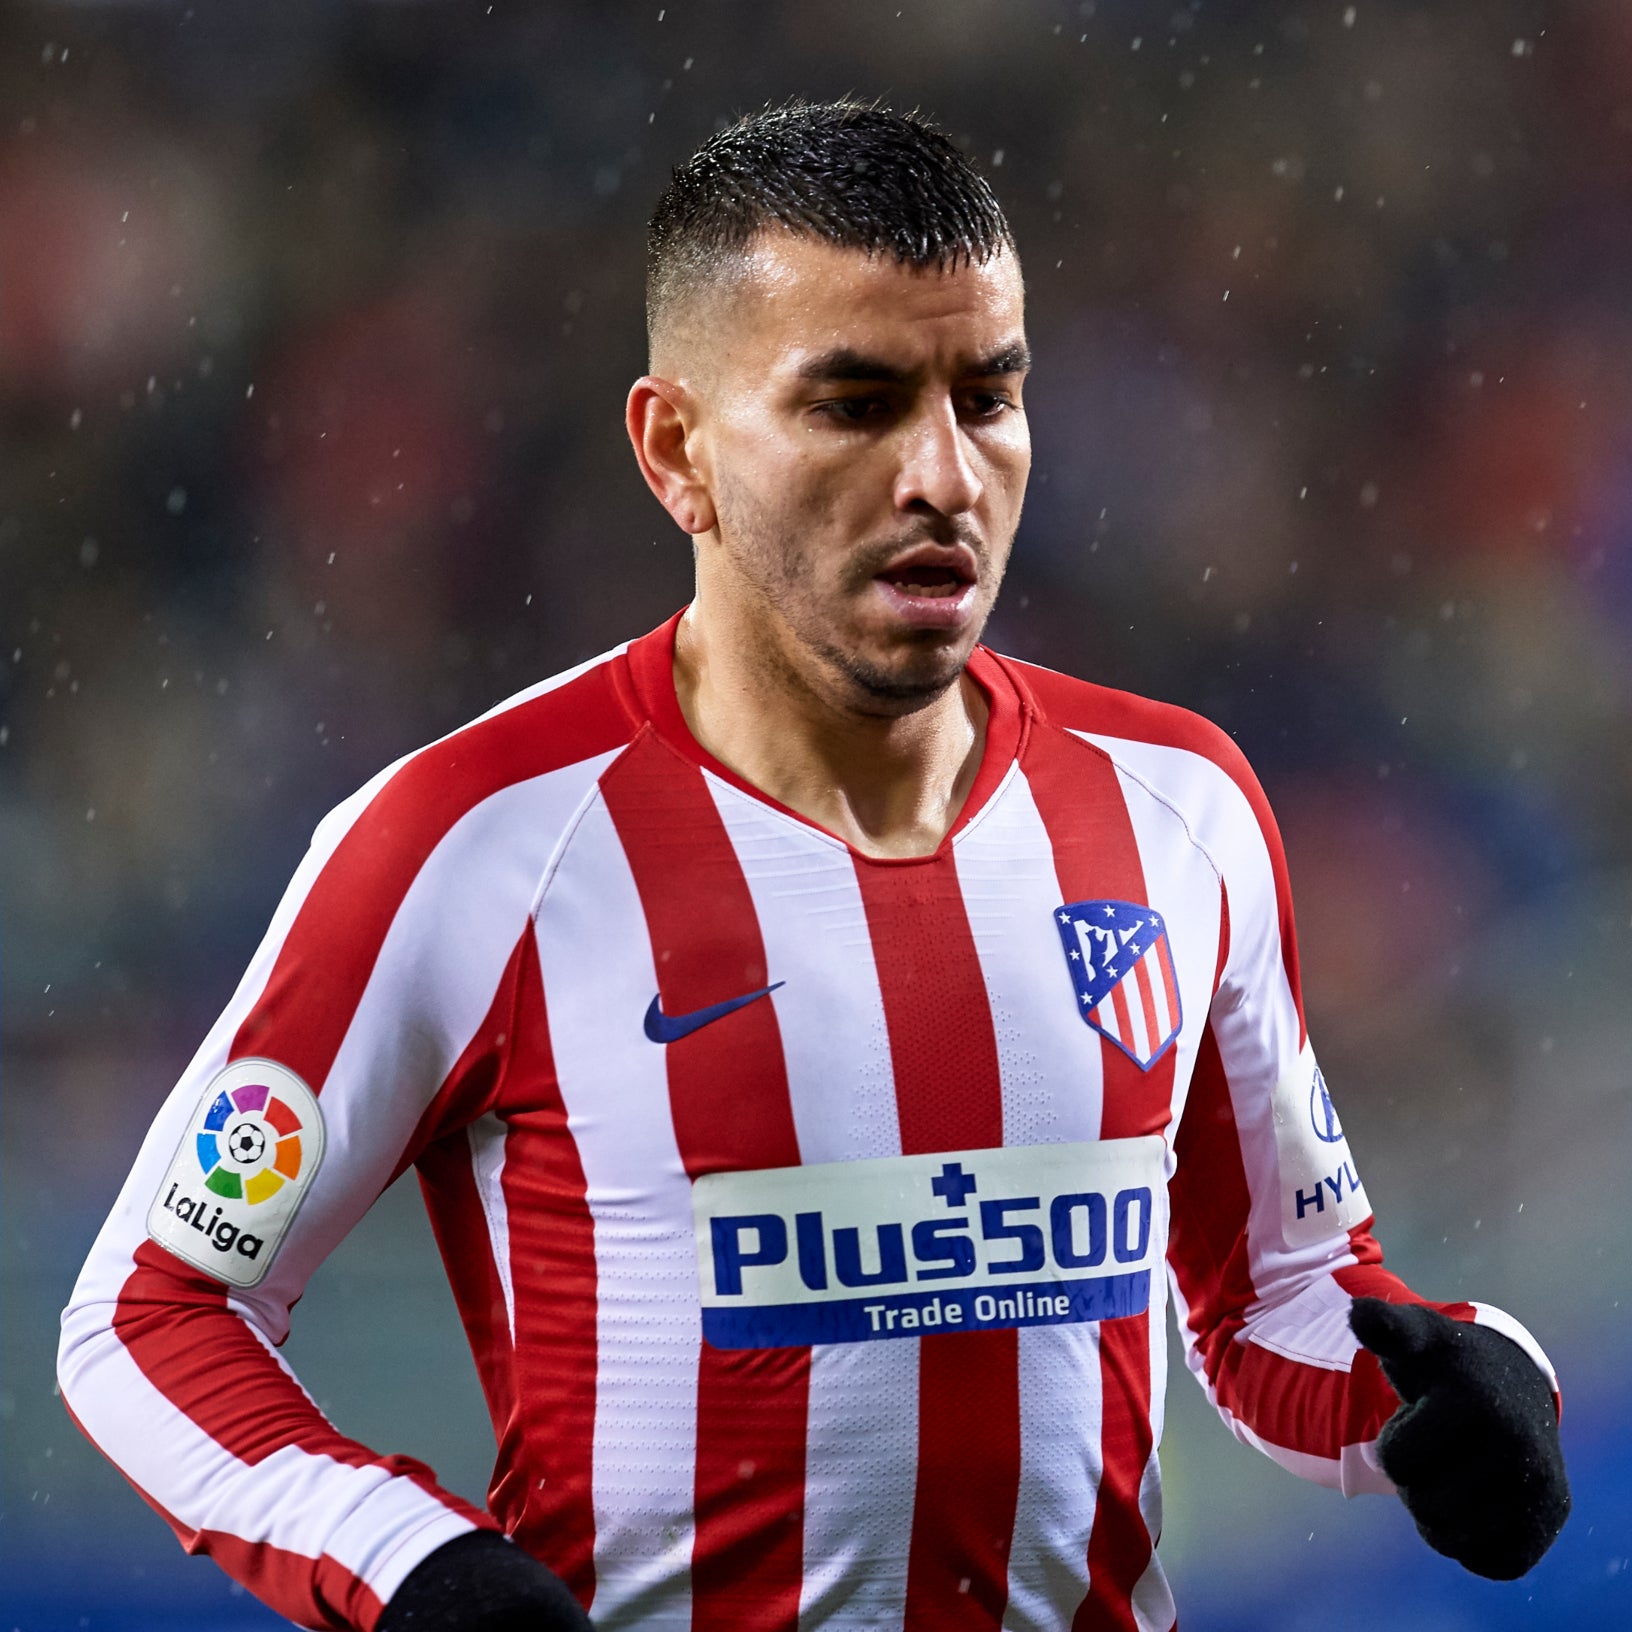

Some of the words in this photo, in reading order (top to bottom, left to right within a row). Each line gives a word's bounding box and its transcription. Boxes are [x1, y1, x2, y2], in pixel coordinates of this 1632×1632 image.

[163, 1182, 265, 1261] LaLiga
[709, 1186, 1153, 1296] Plus500
[863, 1295, 963, 1332] Trade
[975, 1289, 1071, 1323] Online
